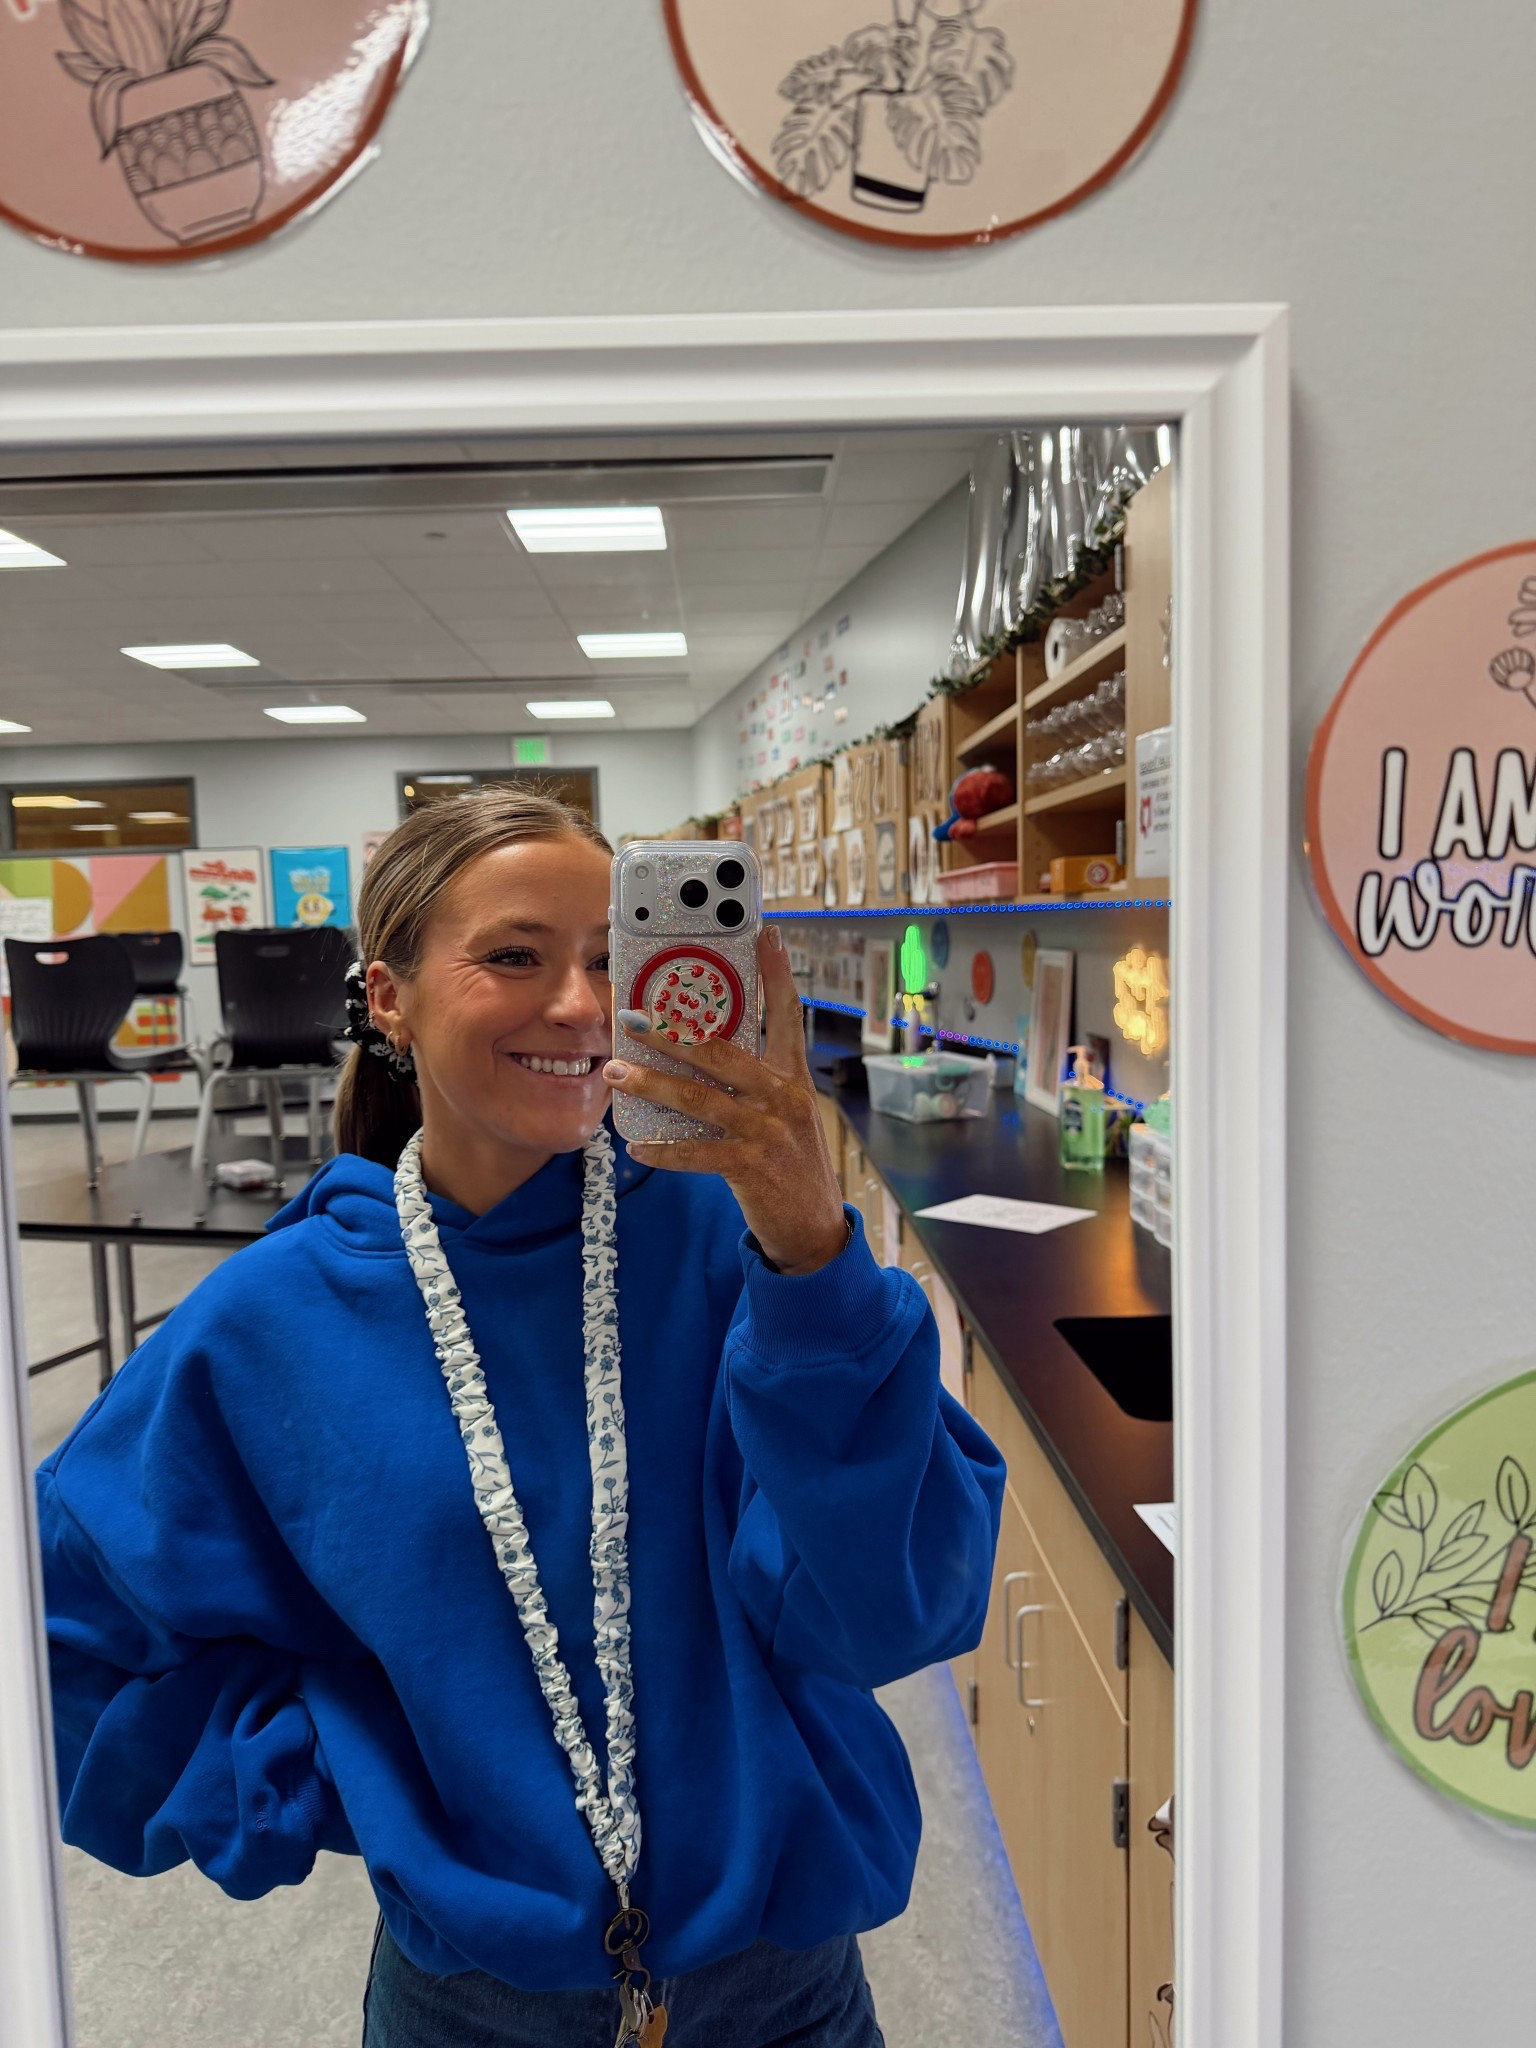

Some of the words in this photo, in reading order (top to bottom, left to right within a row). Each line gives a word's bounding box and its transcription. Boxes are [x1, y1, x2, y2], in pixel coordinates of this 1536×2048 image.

[1379, 747, 1407, 859] I
[1432, 747, 1536, 859] AM
[1486, 1533, 1533, 1632] I
